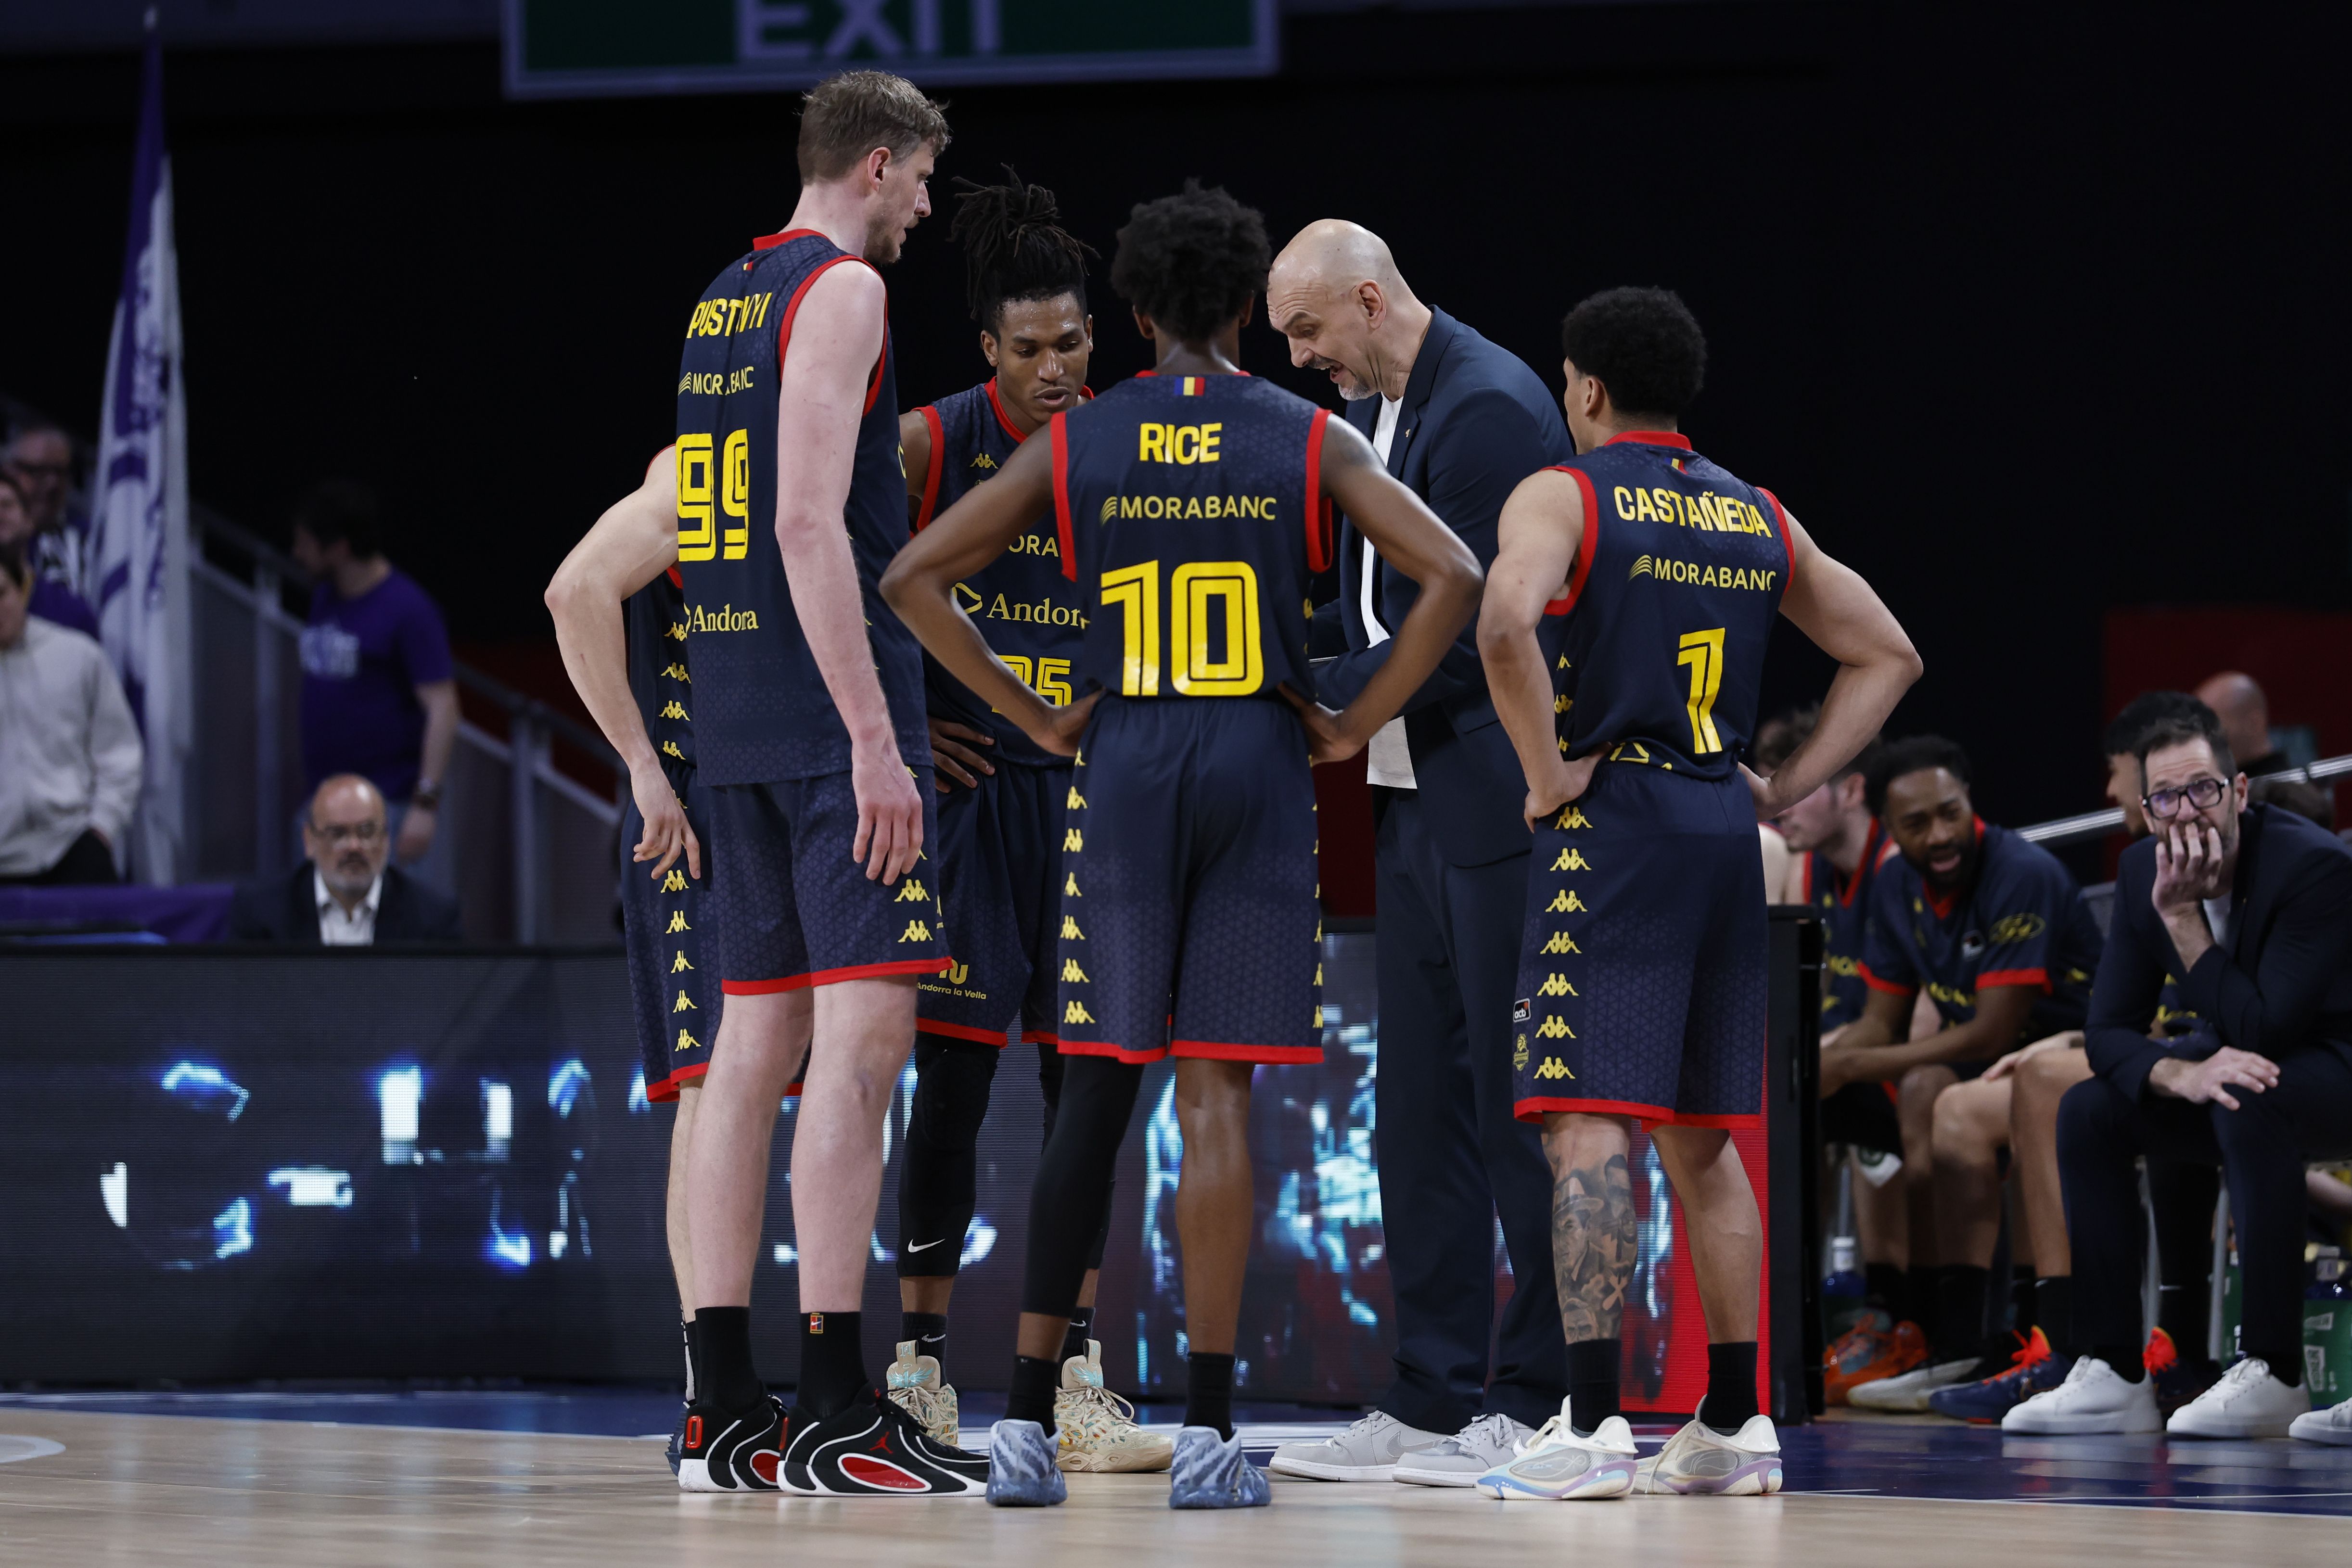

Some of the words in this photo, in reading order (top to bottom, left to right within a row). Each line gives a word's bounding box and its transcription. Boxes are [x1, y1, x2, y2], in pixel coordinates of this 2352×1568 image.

[687, 293, 772, 339] PUSTVYI
[1139, 422, 1223, 465] RICE
[675, 429, 750, 562] 99
[1120, 495, 1278, 521] MORABANC
[1613, 486, 1773, 538] CASTAÑEDA
[1100, 560, 1265, 697] 10
[1677, 627, 1726, 754] 1
[918, 982, 951, 994] Andorra
[954, 988, 962, 996] la
[964, 990, 986, 999] Vella
[1514, 1008, 1526, 1019] acb
